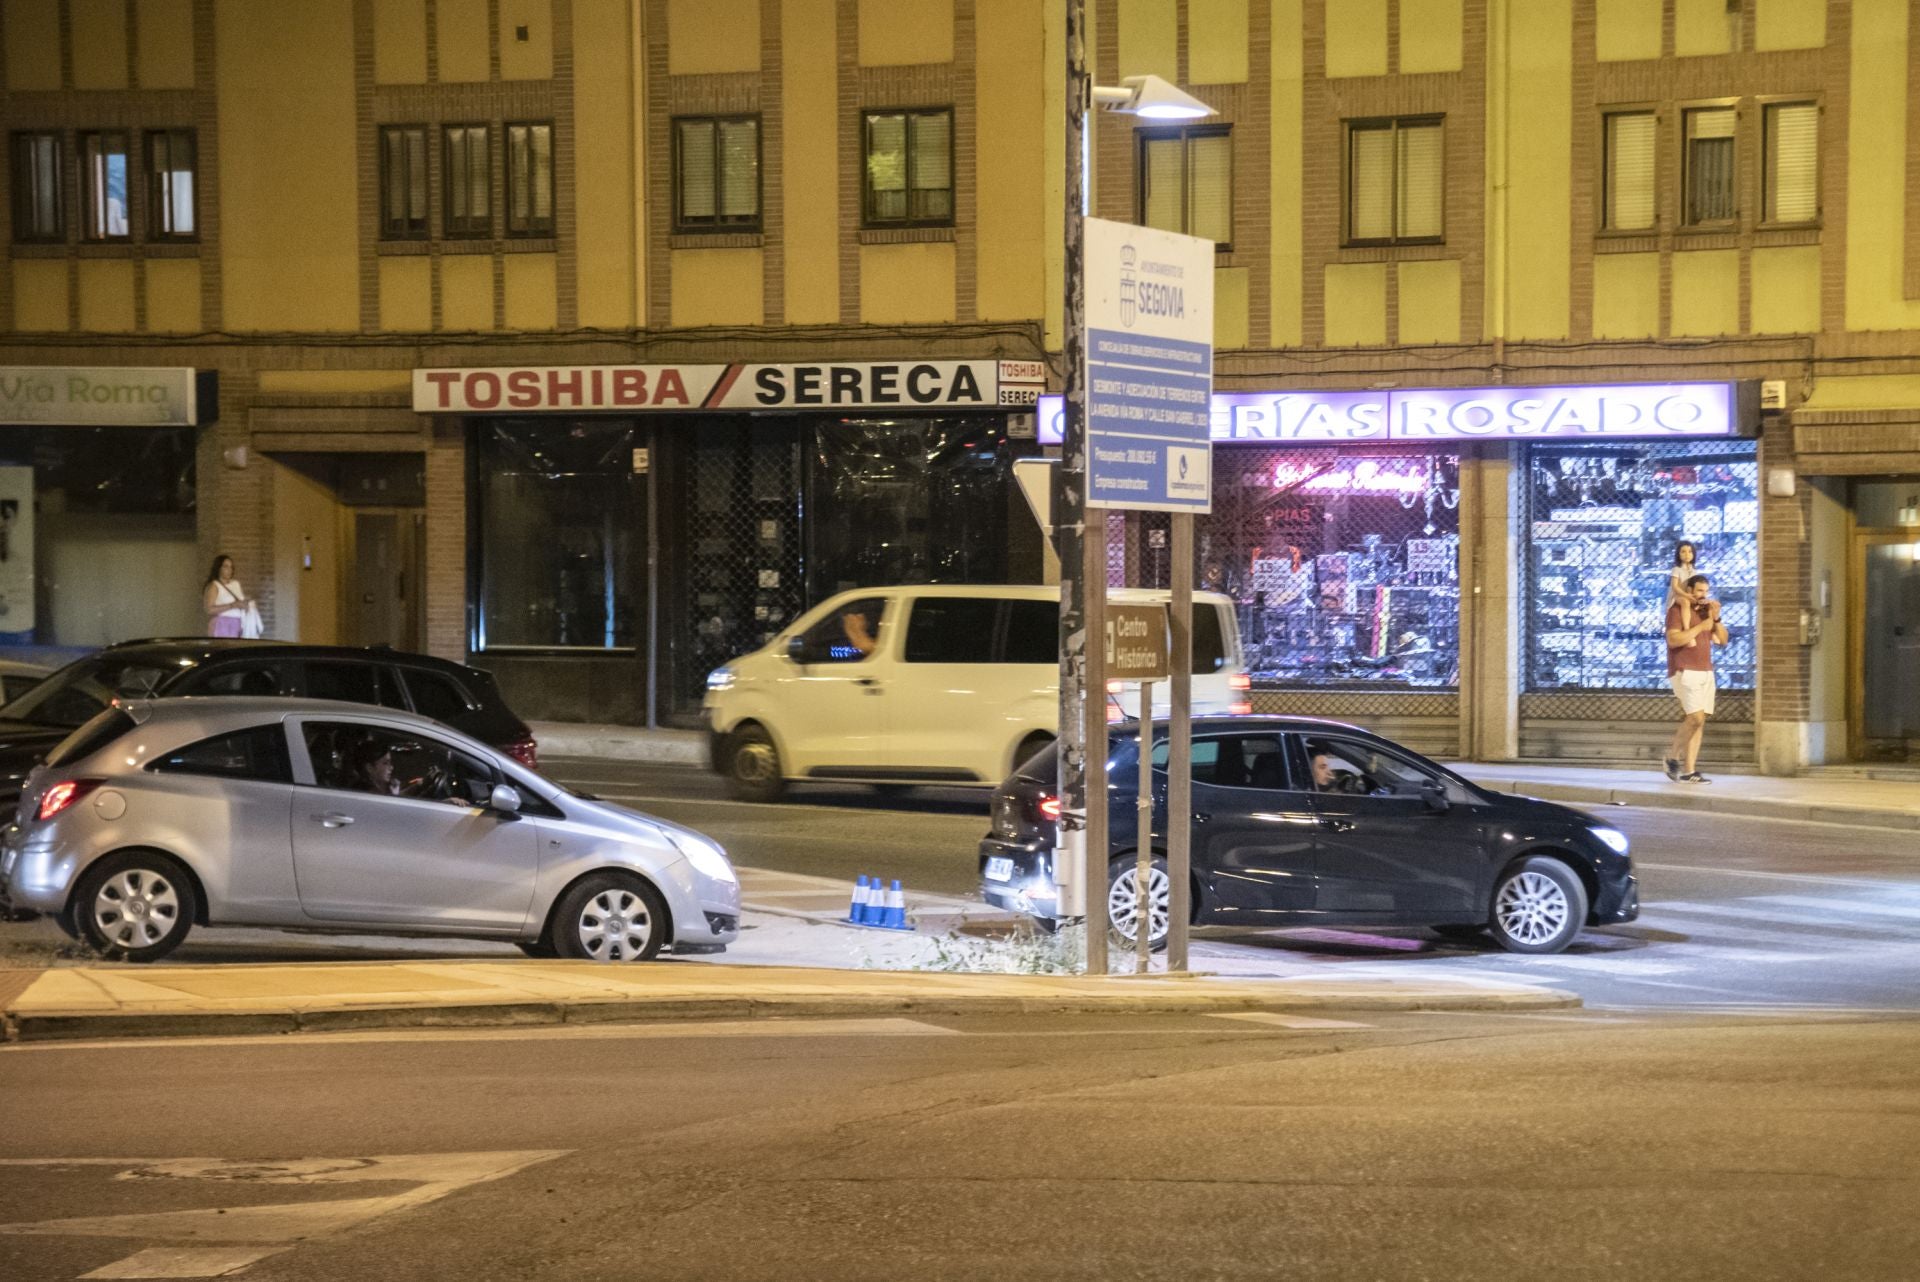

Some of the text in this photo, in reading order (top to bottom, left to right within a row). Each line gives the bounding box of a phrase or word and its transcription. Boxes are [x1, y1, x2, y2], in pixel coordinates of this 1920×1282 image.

[1138, 281, 1184, 319] SEGOVIA
[1000, 363, 1043, 379] TOSHIBA
[0, 376, 169, 404] Vía Roma
[426, 363, 983, 410] TOSHIBA SERECA
[1000, 390, 1041, 404] SEREC
[1400, 394, 1711, 436] ROSADO
[1117, 615, 1148, 637] Centro
[1116, 646, 1158, 670] Histórico
